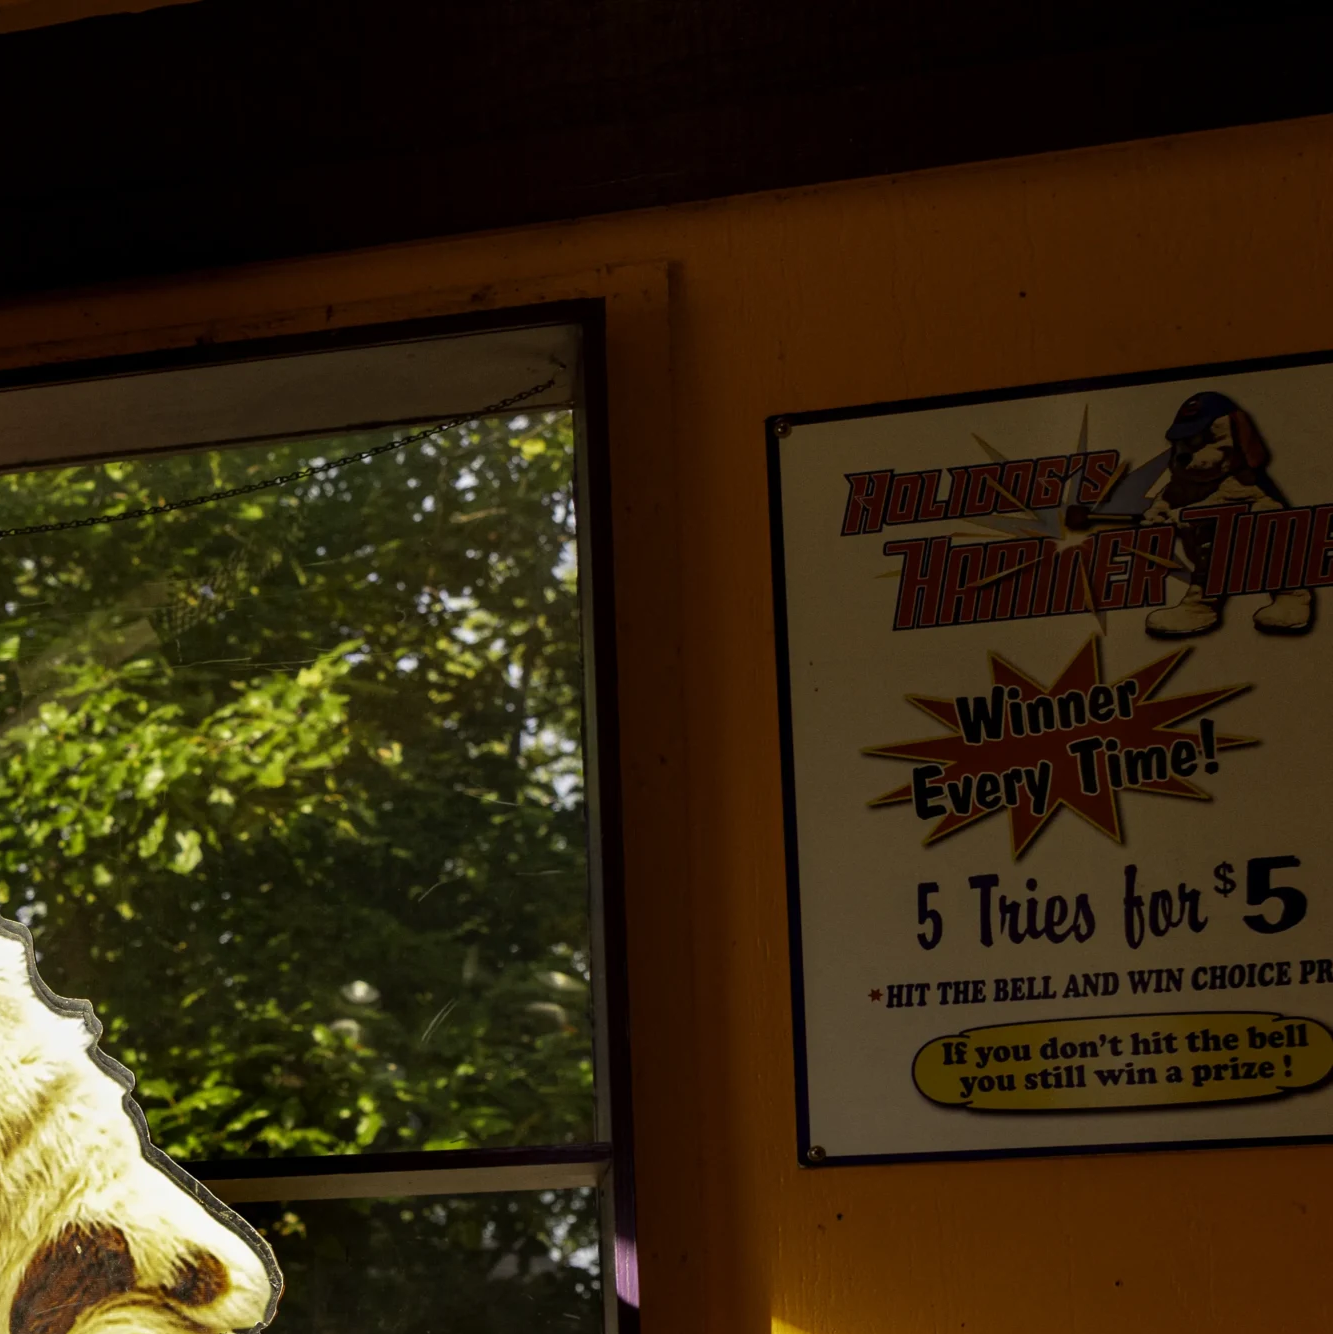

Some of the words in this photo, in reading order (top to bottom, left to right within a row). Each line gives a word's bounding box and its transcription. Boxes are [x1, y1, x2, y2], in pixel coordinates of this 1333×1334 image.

[841, 449, 1120, 537] HOLIDOG'S
[883, 525, 1177, 631] HAMMER
[1181, 502, 1333, 597] TIME
[956, 680, 1138, 745] Winner
[911, 760, 1053, 820] Every
[1069, 718, 1220, 796] Time!
[917, 882, 943, 950] 5
[969, 874, 1096, 948] Tries
[1124, 864, 1208, 949] for
[1213, 855, 1308, 934] $5
[886, 983, 930, 1008] HIT
[937, 979, 986, 1005] THE
[993, 976, 1057, 1002] BELL
[1062, 970, 1119, 998] AND
[1128, 968, 1184, 994] WIN
[1191, 961, 1291, 991] CHOICE
[942, 1042, 967, 1065] If
[974, 1045, 1032, 1068] you
[1039, 1034, 1123, 1060] don't
[1130, 1032, 1177, 1055] hit
[1186, 1029, 1239, 1052] the
[1247, 1023, 1309, 1048] bell
[960, 1075, 1017, 1098] you
[1024, 1064, 1086, 1090] still
[1094, 1062, 1157, 1086] win
[1165, 1065, 1183, 1083] a
[1191, 1057, 1275, 1087] prize
